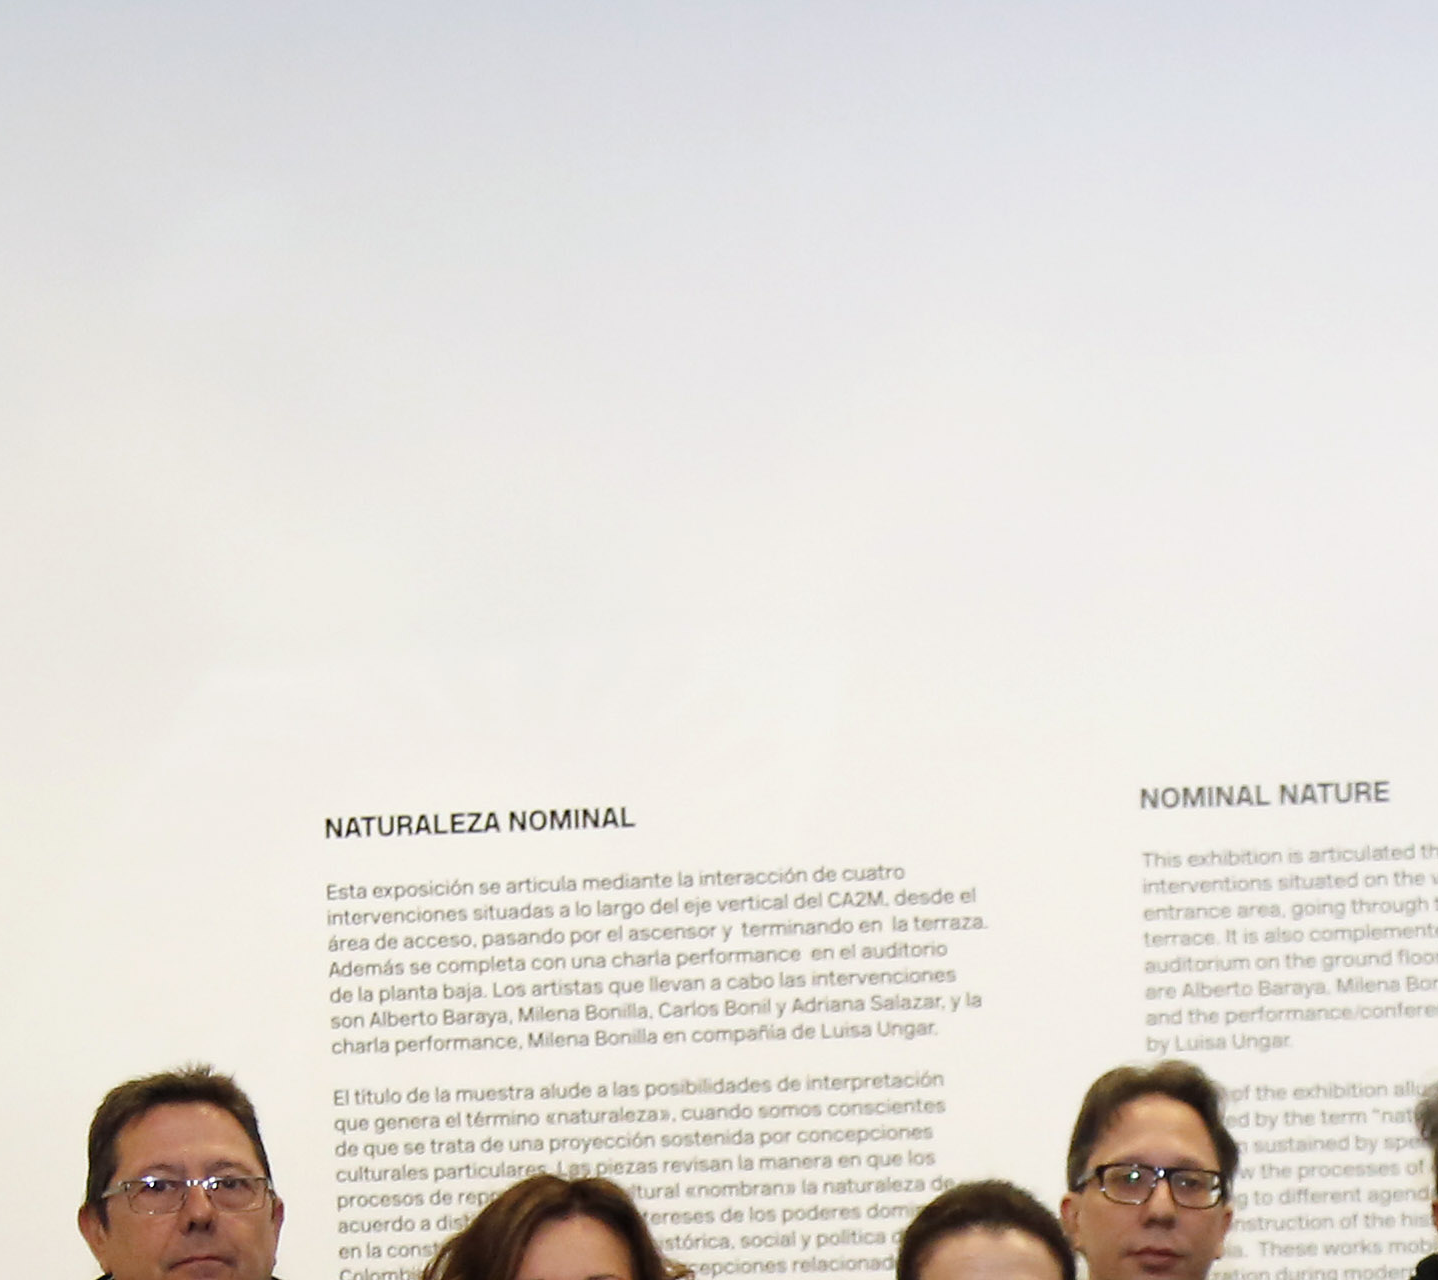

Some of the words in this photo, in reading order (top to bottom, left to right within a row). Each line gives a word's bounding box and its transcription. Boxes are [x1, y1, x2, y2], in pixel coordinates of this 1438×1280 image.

[1140, 784, 1271, 809] NOMINAL
[1279, 779, 1389, 806] NATURE
[325, 811, 500, 839] NATURALEZA
[509, 806, 635, 832] NOMINAL
[1141, 850, 1182, 869] This
[1186, 848, 1283, 867] exhibition
[1287, 848, 1303, 864] is
[1307, 842, 1415, 864] articulated
[326, 883, 367, 901] Esta
[372, 877, 474, 902] exposición
[479, 880, 501, 895] se
[506, 875, 577, 895] articula
[582, 871, 672, 891] mediante
[677, 871, 694, 888] la
[699, 867, 808, 887] interacción
[812, 865, 837, 883] de
[842, 864, 905, 882] cuatro
[1142, 876, 1272, 895] interventions
[1278, 871, 1359, 891] situated
[1362, 872, 1388, 888] on
[1393, 868, 1425, 887] the
[327, 906, 468, 926] intervenciones
[473, 902, 554, 921] situadas
[559, 903, 570, 919] a
[575, 900, 592, 918] lo
[596, 899, 645, 920] largo
[649, 897, 679, 915] del
[683, 896, 711, 917] eje
[717, 892, 788, 912] vertical
[793, 891, 822, 910] del
[894, 888, 954, 906] desde
[959, 887, 976, 904] el
[1142, 904, 1231, 922] entrance
[1290, 901, 1346, 922] going
[1350, 896, 1429, 917] through
[328, 934, 369, 953] área
[374, 932, 398, 951] de
[482, 927, 565, 950] pasando
[569, 929, 602, 947] por
[607, 925, 623, 943] el
[628, 925, 717, 942] ascensor
[722, 924, 733, 943] y
[741, 917, 854, 938] terminando
[859, 919, 882, 934] en
[892, 915, 908, 933] la
[329, 958, 404, 979] Además
[410, 960, 431, 975] se
[436, 955, 526, 976] completa
[530, 956, 566, 971] con
[571, 954, 606, 970] una
[611, 948, 671, 969] charla
[676, 947, 801, 970] performance
[810, 947, 834, 961] en
[839, 943, 856, 961] el
[861, 941, 947, 960] auditorio
